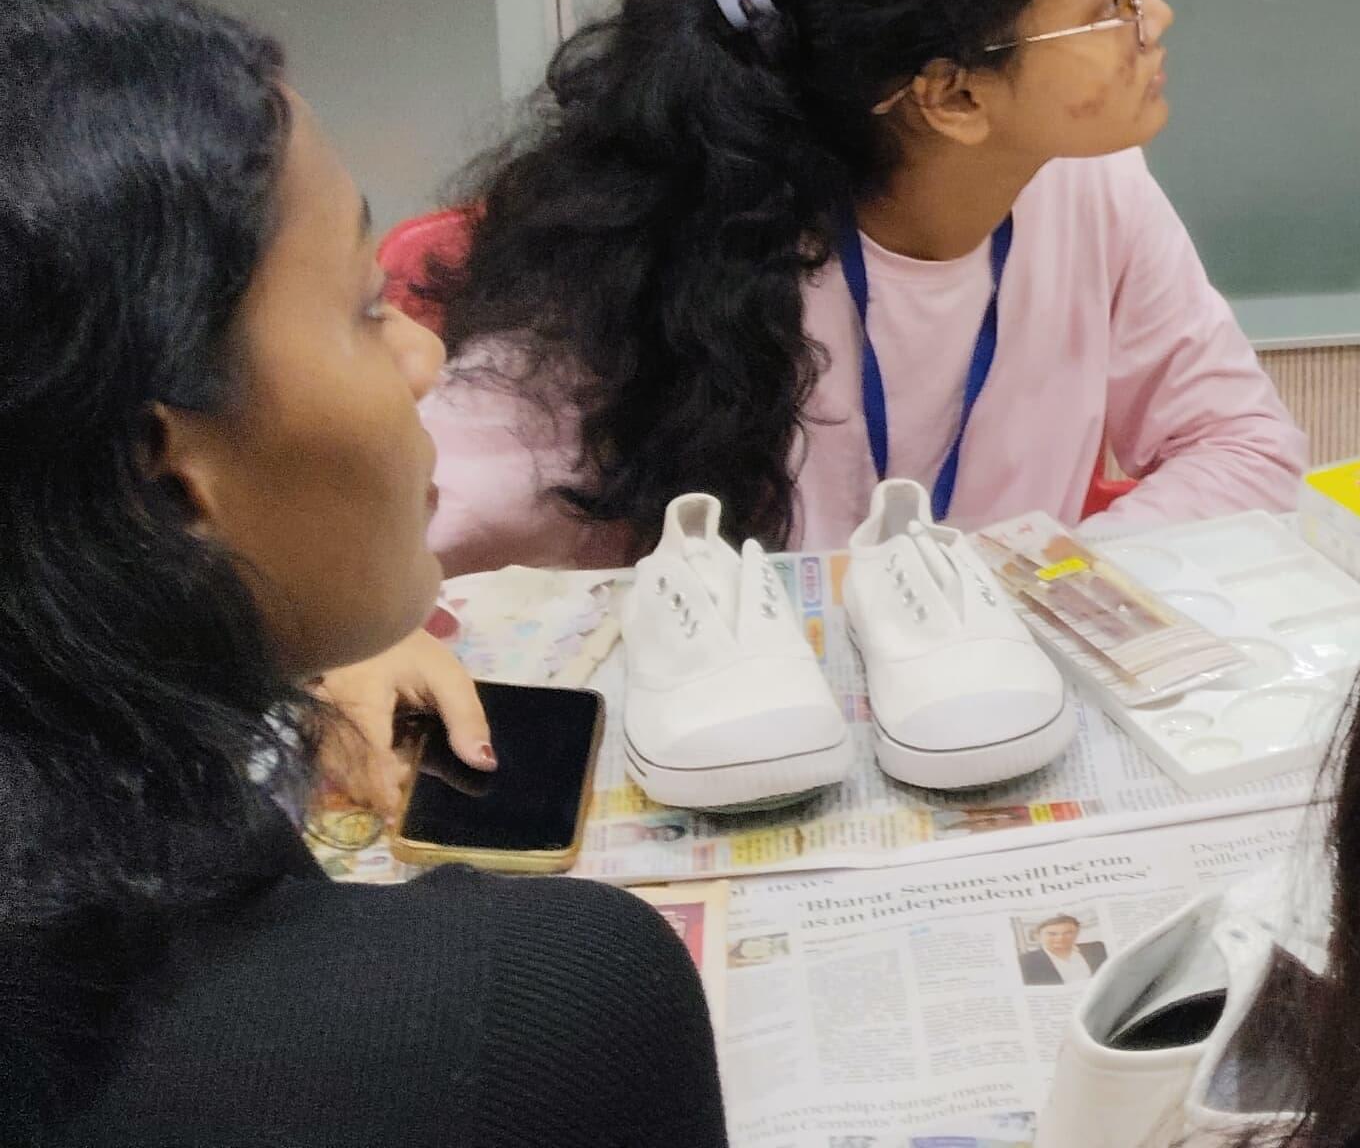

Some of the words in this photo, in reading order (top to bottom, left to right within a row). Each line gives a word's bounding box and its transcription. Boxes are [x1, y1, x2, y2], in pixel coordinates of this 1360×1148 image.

[900, 876, 998, 894] Serums
[1003, 866, 1048, 883] will
[1053, 862, 1083, 876] be
[1089, 855, 1132, 868] run
[802, 918, 832, 929] as
[834, 913, 865, 927] an
[871, 888, 1033, 919] independent
